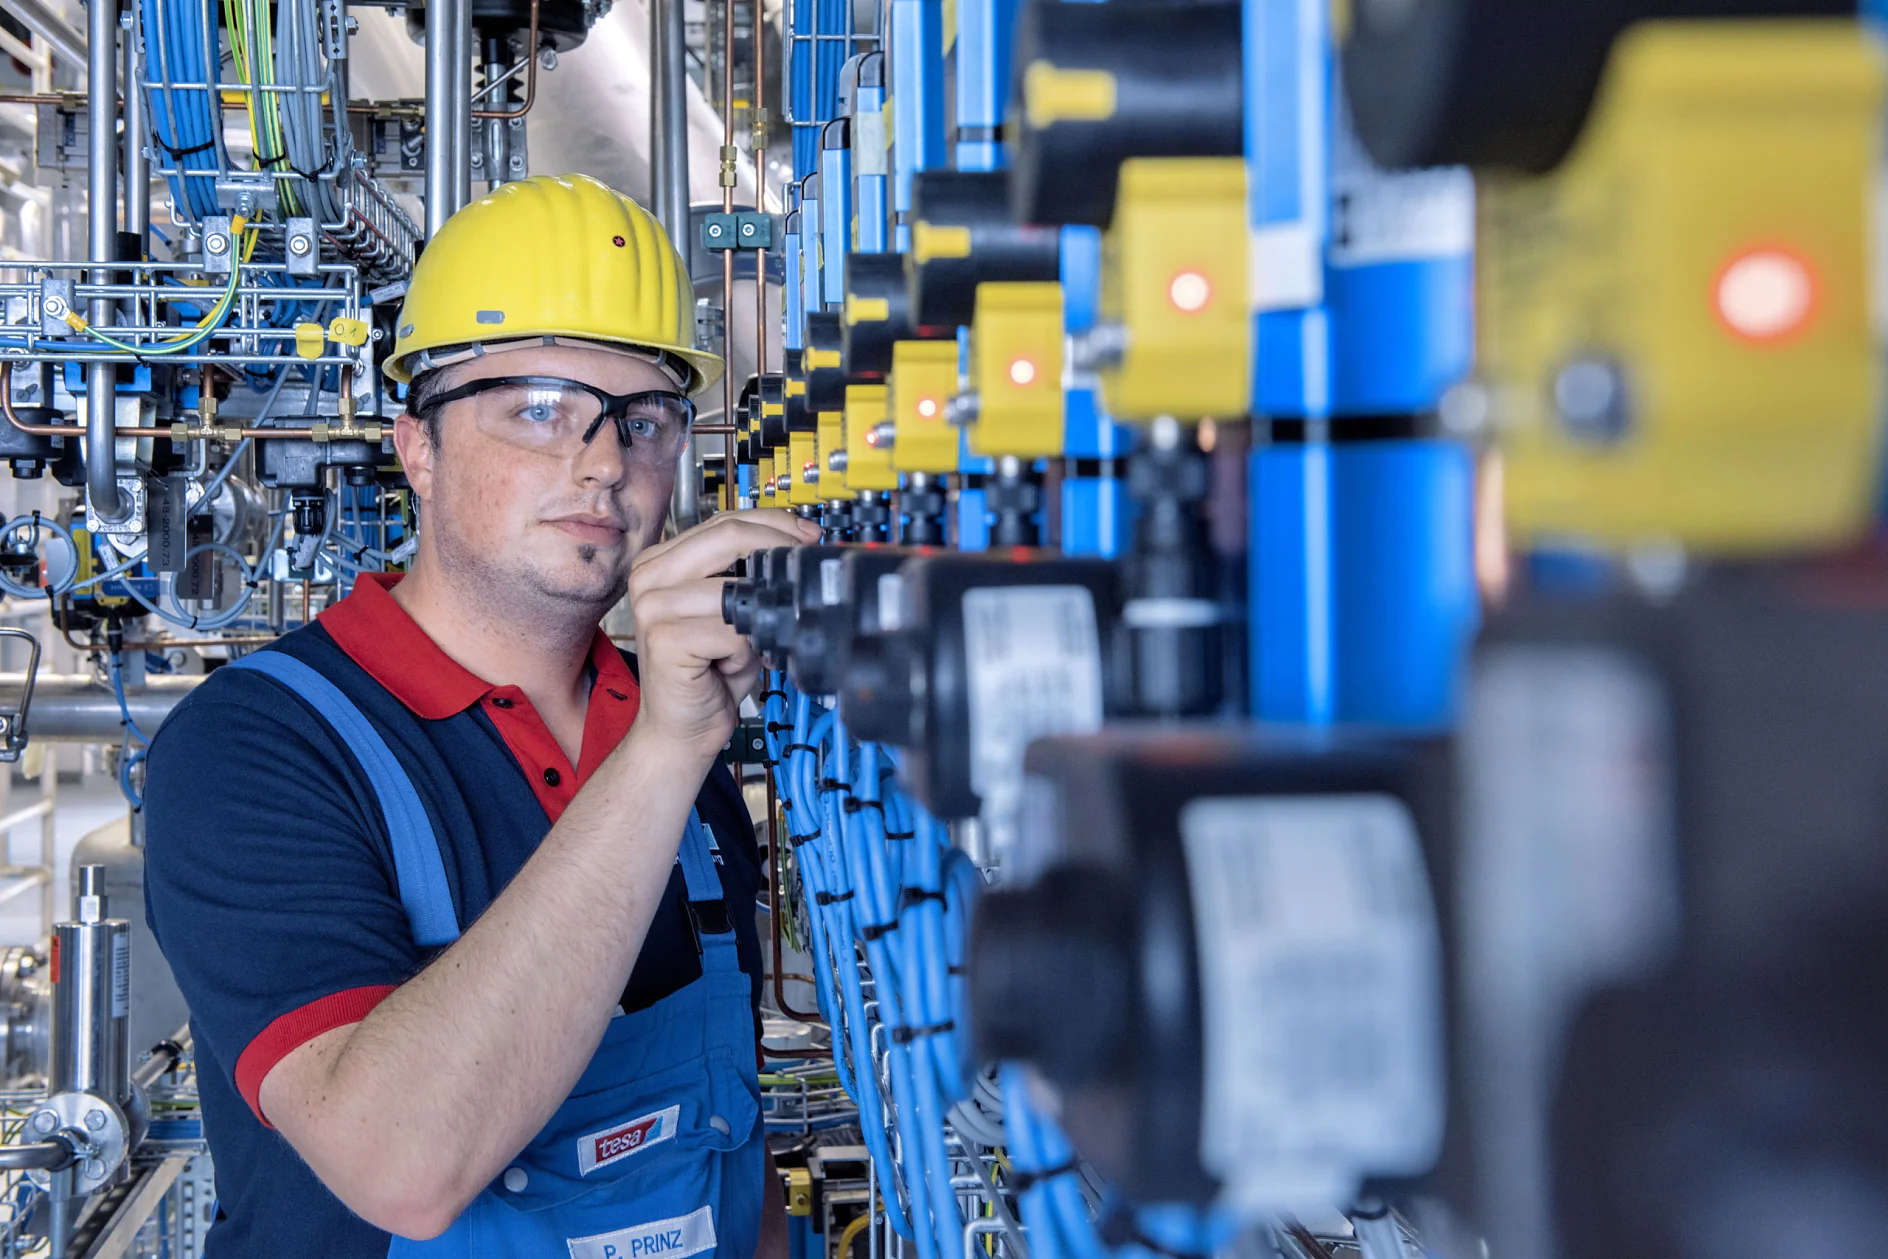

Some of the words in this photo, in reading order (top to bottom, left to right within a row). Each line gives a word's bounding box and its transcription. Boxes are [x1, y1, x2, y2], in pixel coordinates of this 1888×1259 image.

[162, 498, 170, 567] 48-2000.73
[192, 532, 200, 595] 48000.72
[598, 1128, 642, 1158] tesa
[603, 1243, 623, 1259] P.
[631, 1228, 684, 1258] PRINZ
